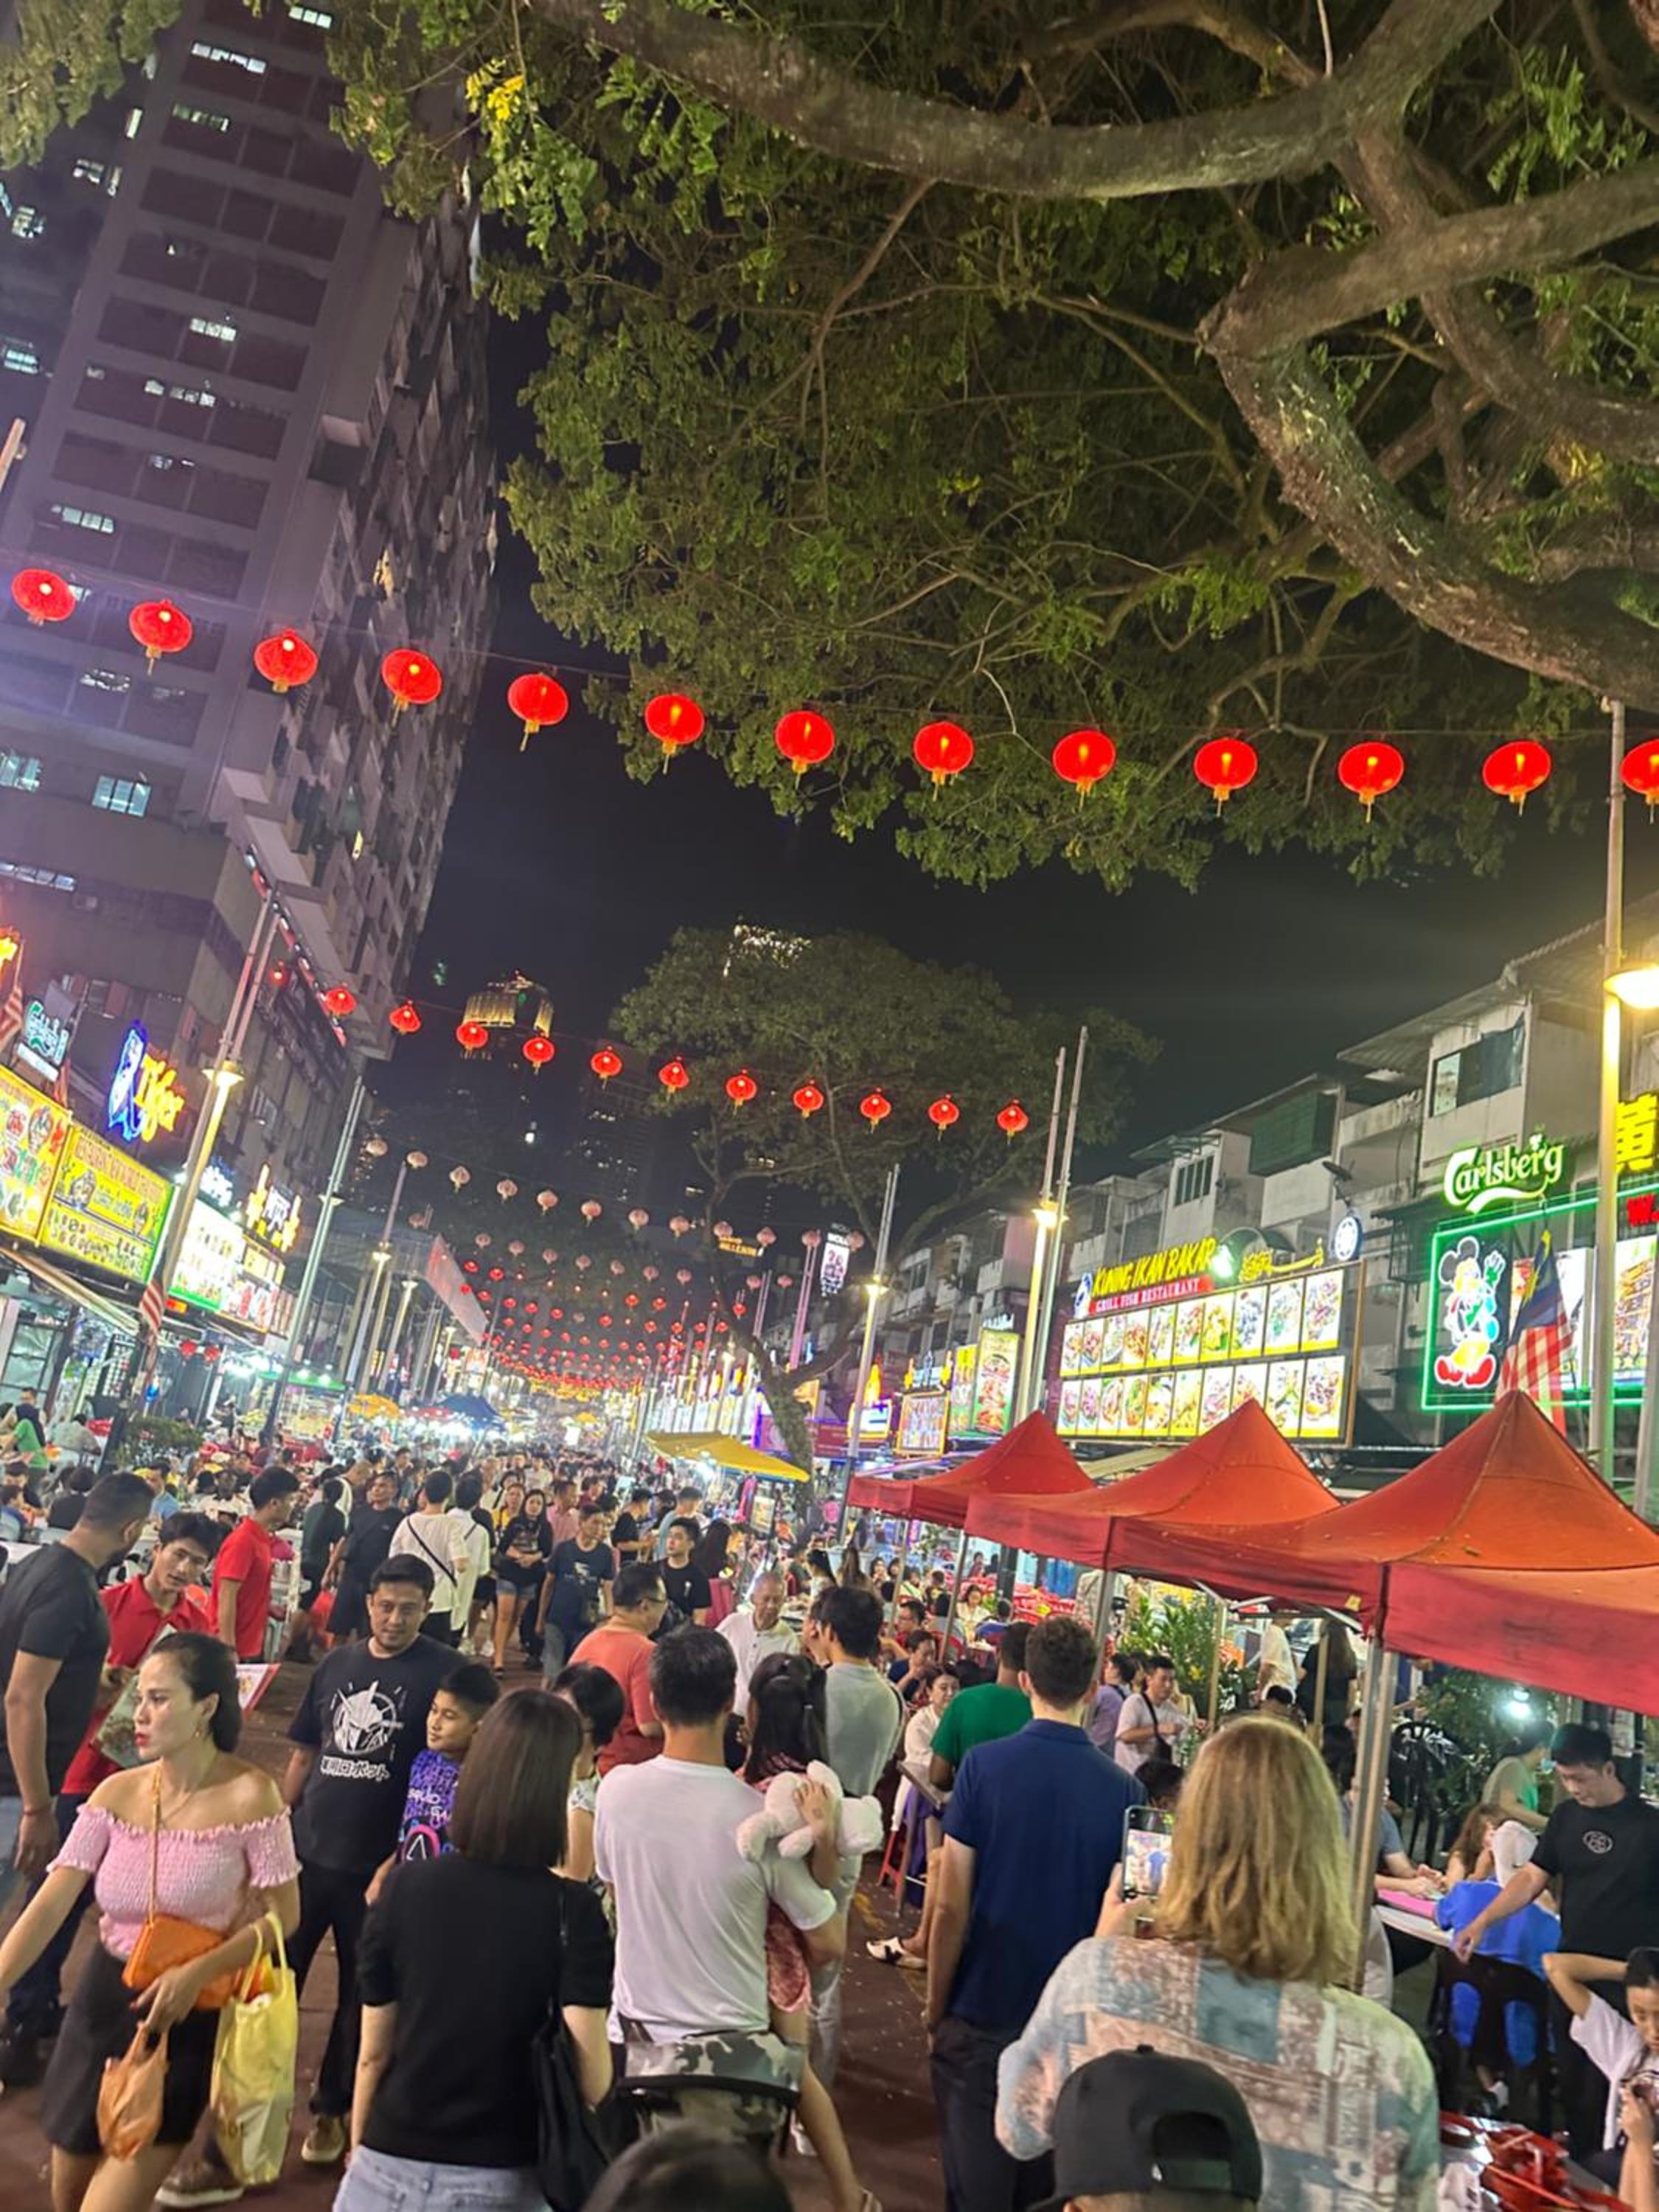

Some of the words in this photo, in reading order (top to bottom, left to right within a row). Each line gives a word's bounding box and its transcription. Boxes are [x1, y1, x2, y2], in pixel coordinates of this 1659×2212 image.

[1444, 1144, 1565, 1206] Carlsberg
[1132, 1252, 1167, 1289] IKAN
[1142, 1276, 1200, 1303] RESTAURANT
